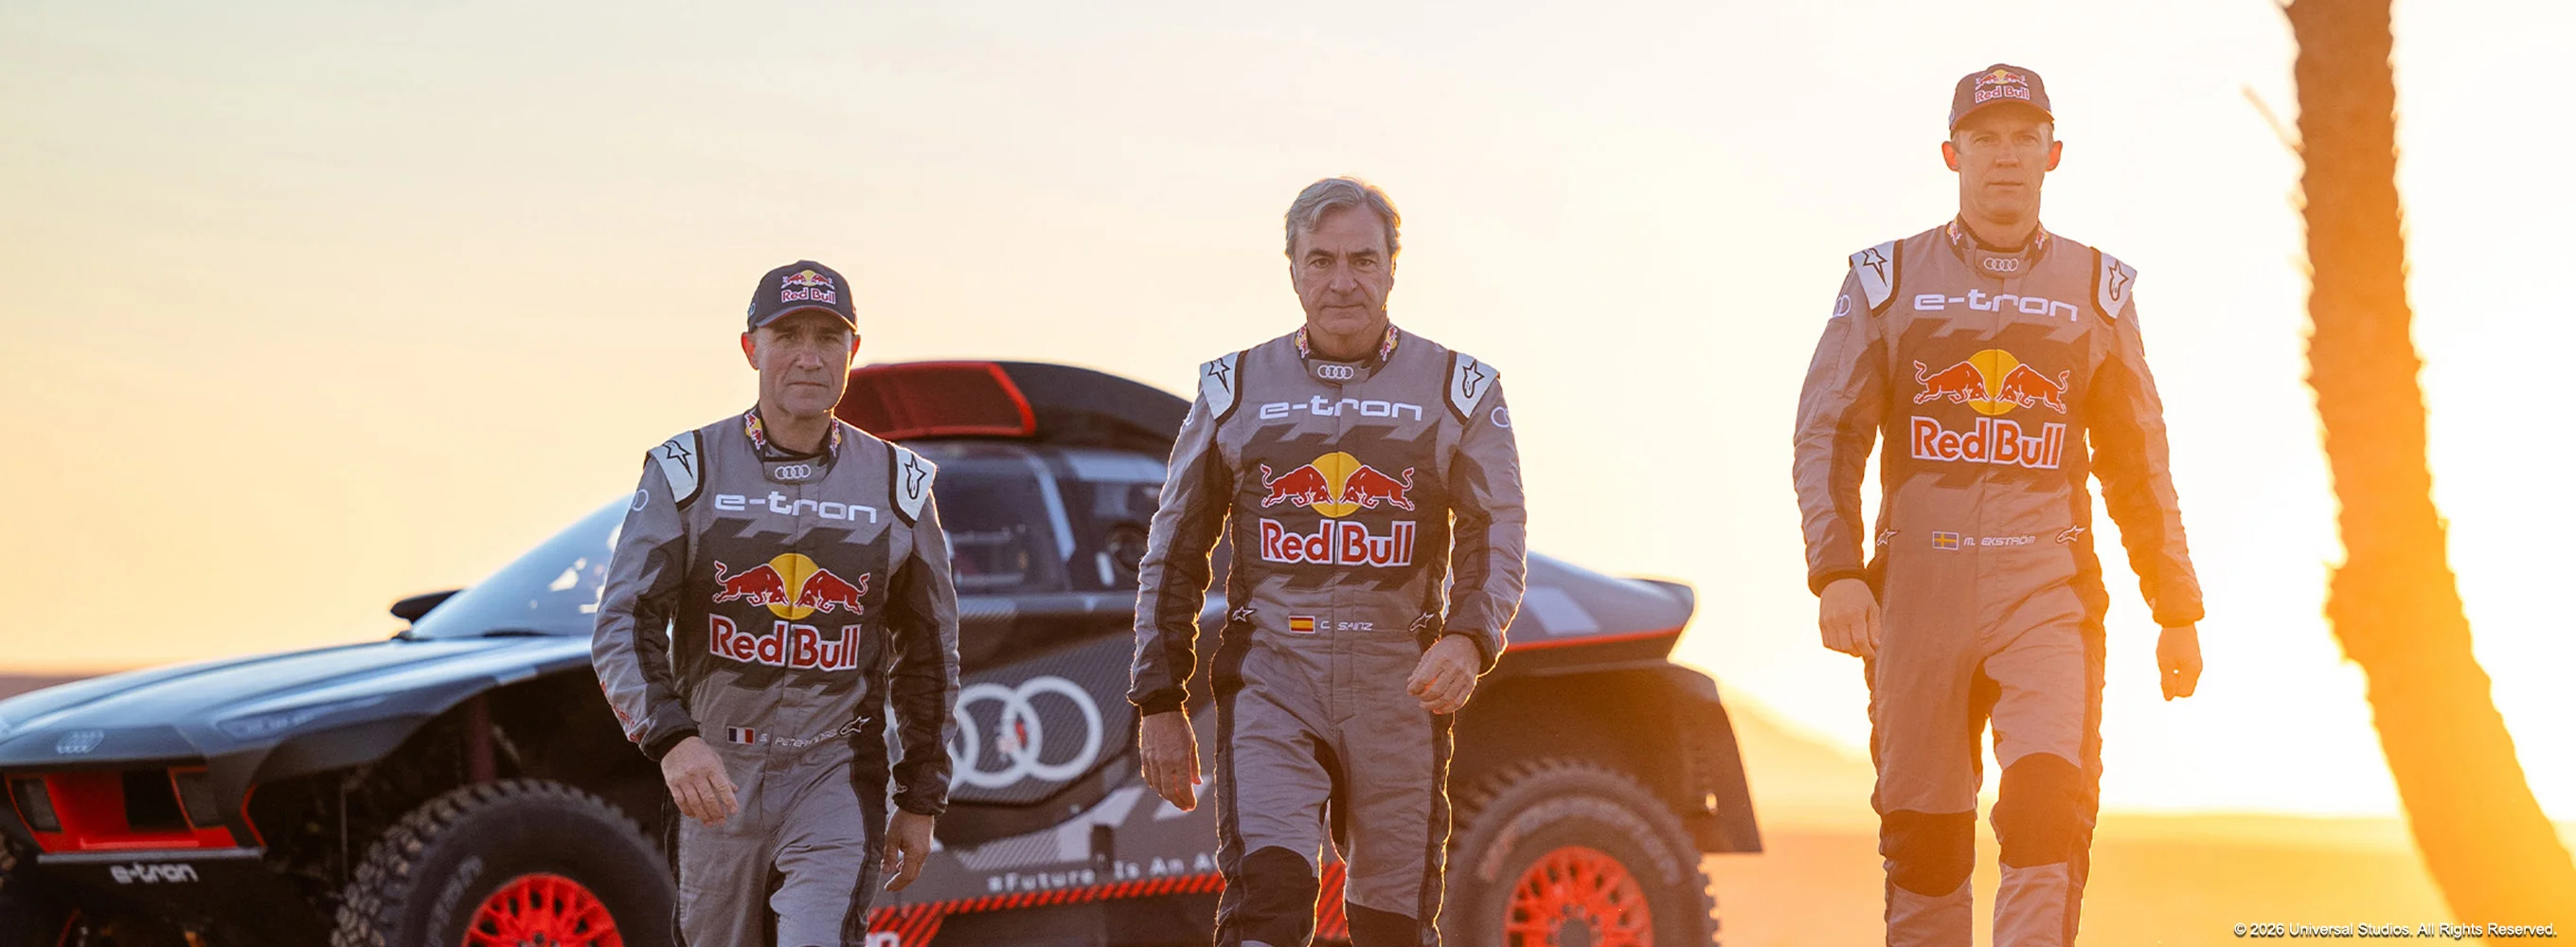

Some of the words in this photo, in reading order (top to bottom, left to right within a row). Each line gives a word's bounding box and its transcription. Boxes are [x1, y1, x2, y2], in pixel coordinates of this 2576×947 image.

[1975, 85, 2002, 103] Red
[2003, 85, 2030, 100] Bull
[781, 287, 809, 303] Red
[811, 288, 835, 304] Bull
[1914, 289, 2078, 322] e-tron
[1260, 395, 1422, 420] e-tron
[1911, 416, 1990, 463] Red
[1991, 419, 2066, 469] Bull
[714, 491, 877, 524] e-tron
[1260, 518, 1335, 564] Red
[1337, 520, 1416, 567] Bull
[1337, 621, 1373, 631] SAINZ
[709, 614, 789, 667] Red
[790, 622, 862, 670] Bull
[110, 863, 199, 884] e-tron
